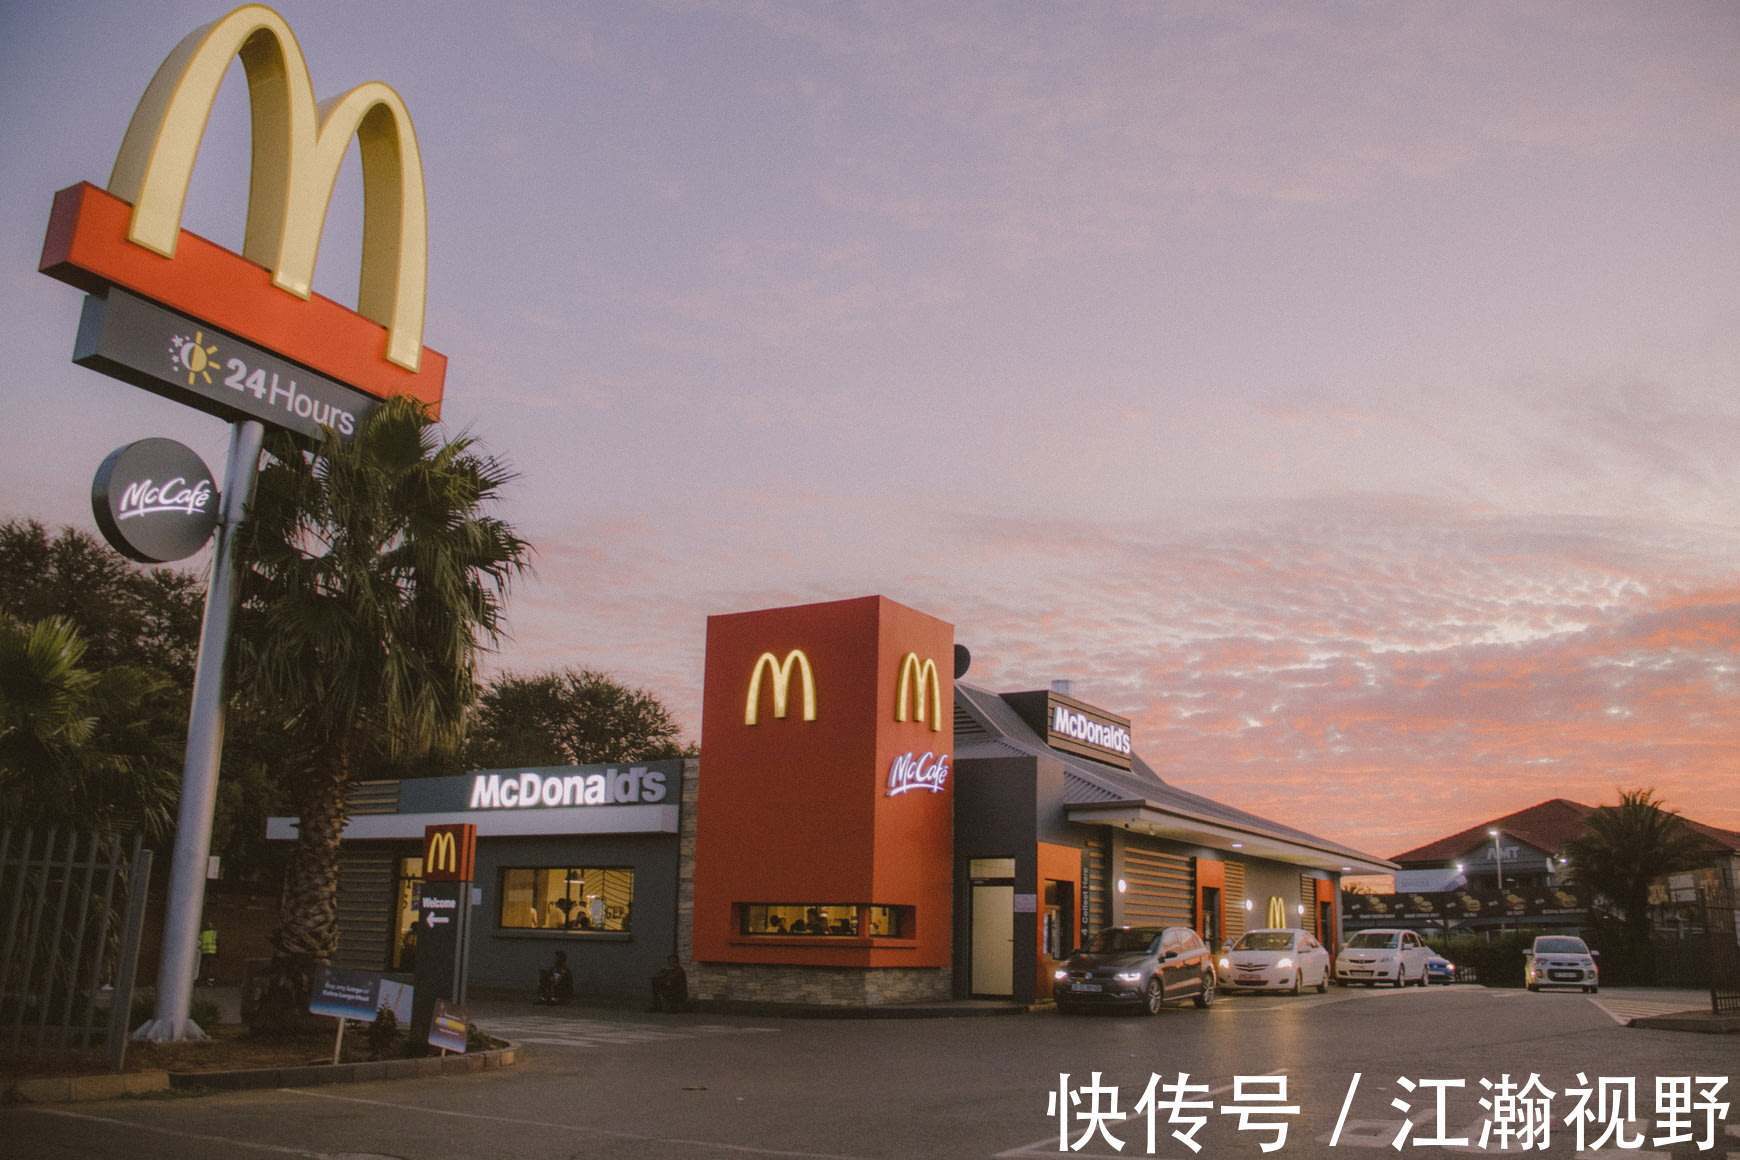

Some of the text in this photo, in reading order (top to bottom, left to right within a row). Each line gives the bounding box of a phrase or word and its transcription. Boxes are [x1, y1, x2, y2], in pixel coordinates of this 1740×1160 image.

[224, 358, 355, 436] 24 Hours
[119, 476, 211, 518] McCafé
[1053, 705, 1132, 755] McDonald's
[470, 766, 667, 808] McDonald's
[887, 751, 949, 796] McCafé
[422, 896, 457, 908] Welcome
